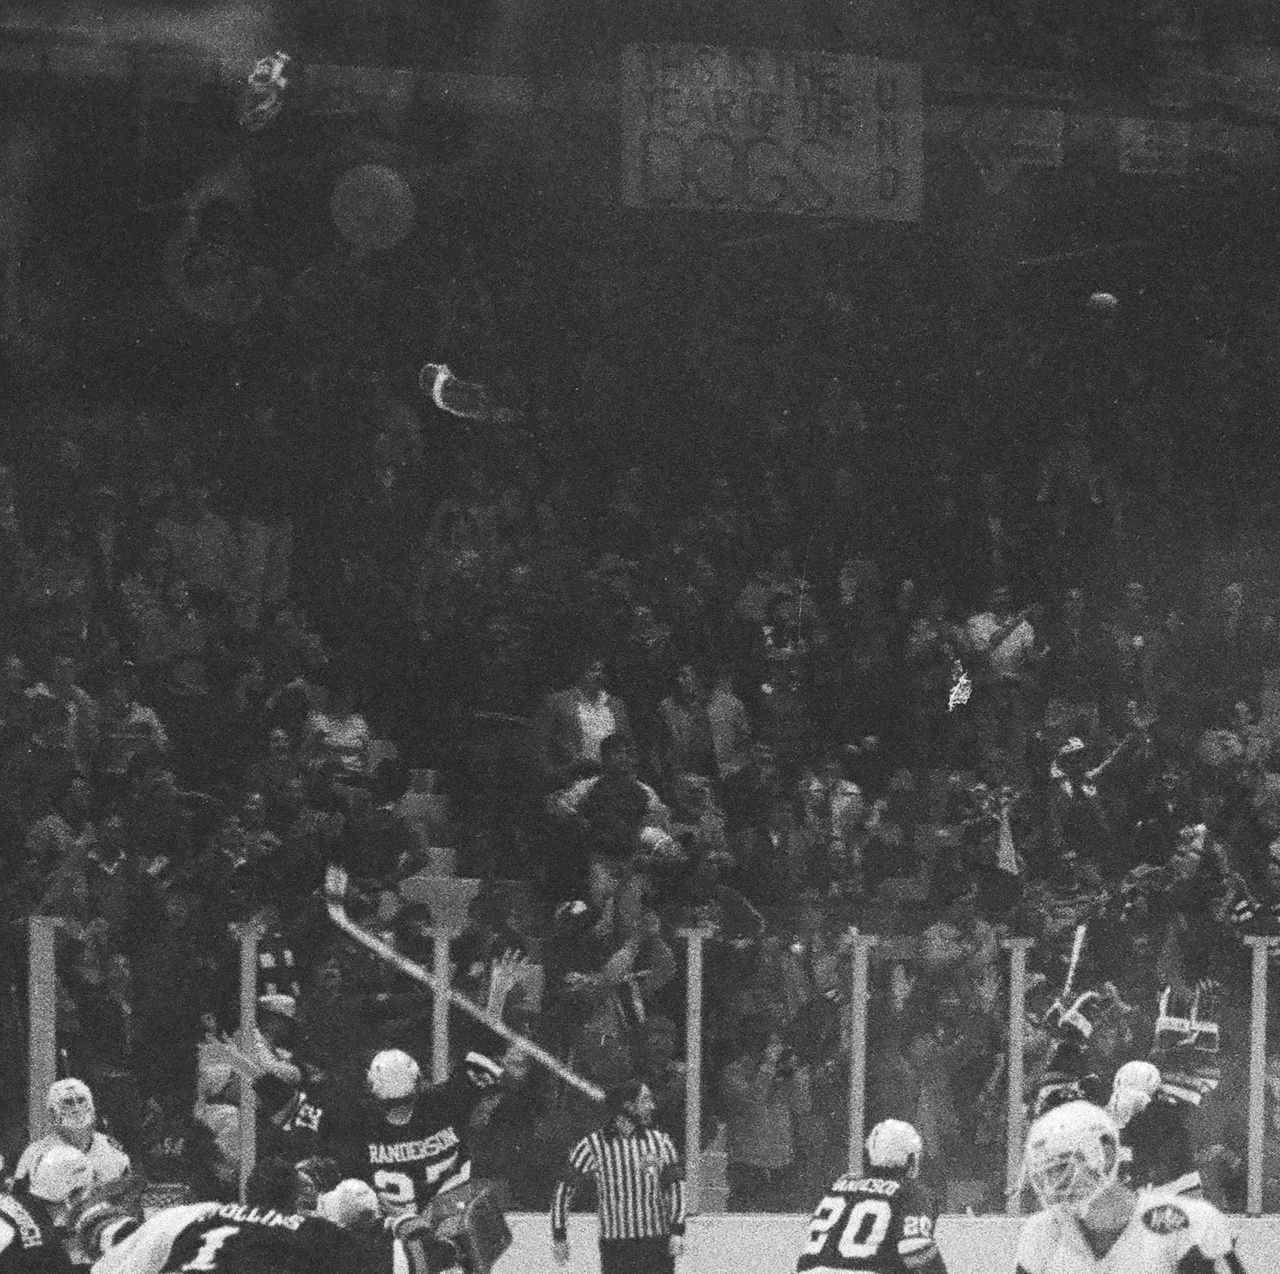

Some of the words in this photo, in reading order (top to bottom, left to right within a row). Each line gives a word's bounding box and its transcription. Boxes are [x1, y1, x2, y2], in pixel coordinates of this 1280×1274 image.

[640, 133, 836, 213] DOGS
[367, 1126, 460, 1163] RANDERSON
[181, 1225, 240, 1271] 1
[803, 1195, 893, 1259] 20
[902, 1214, 934, 1238] 20
